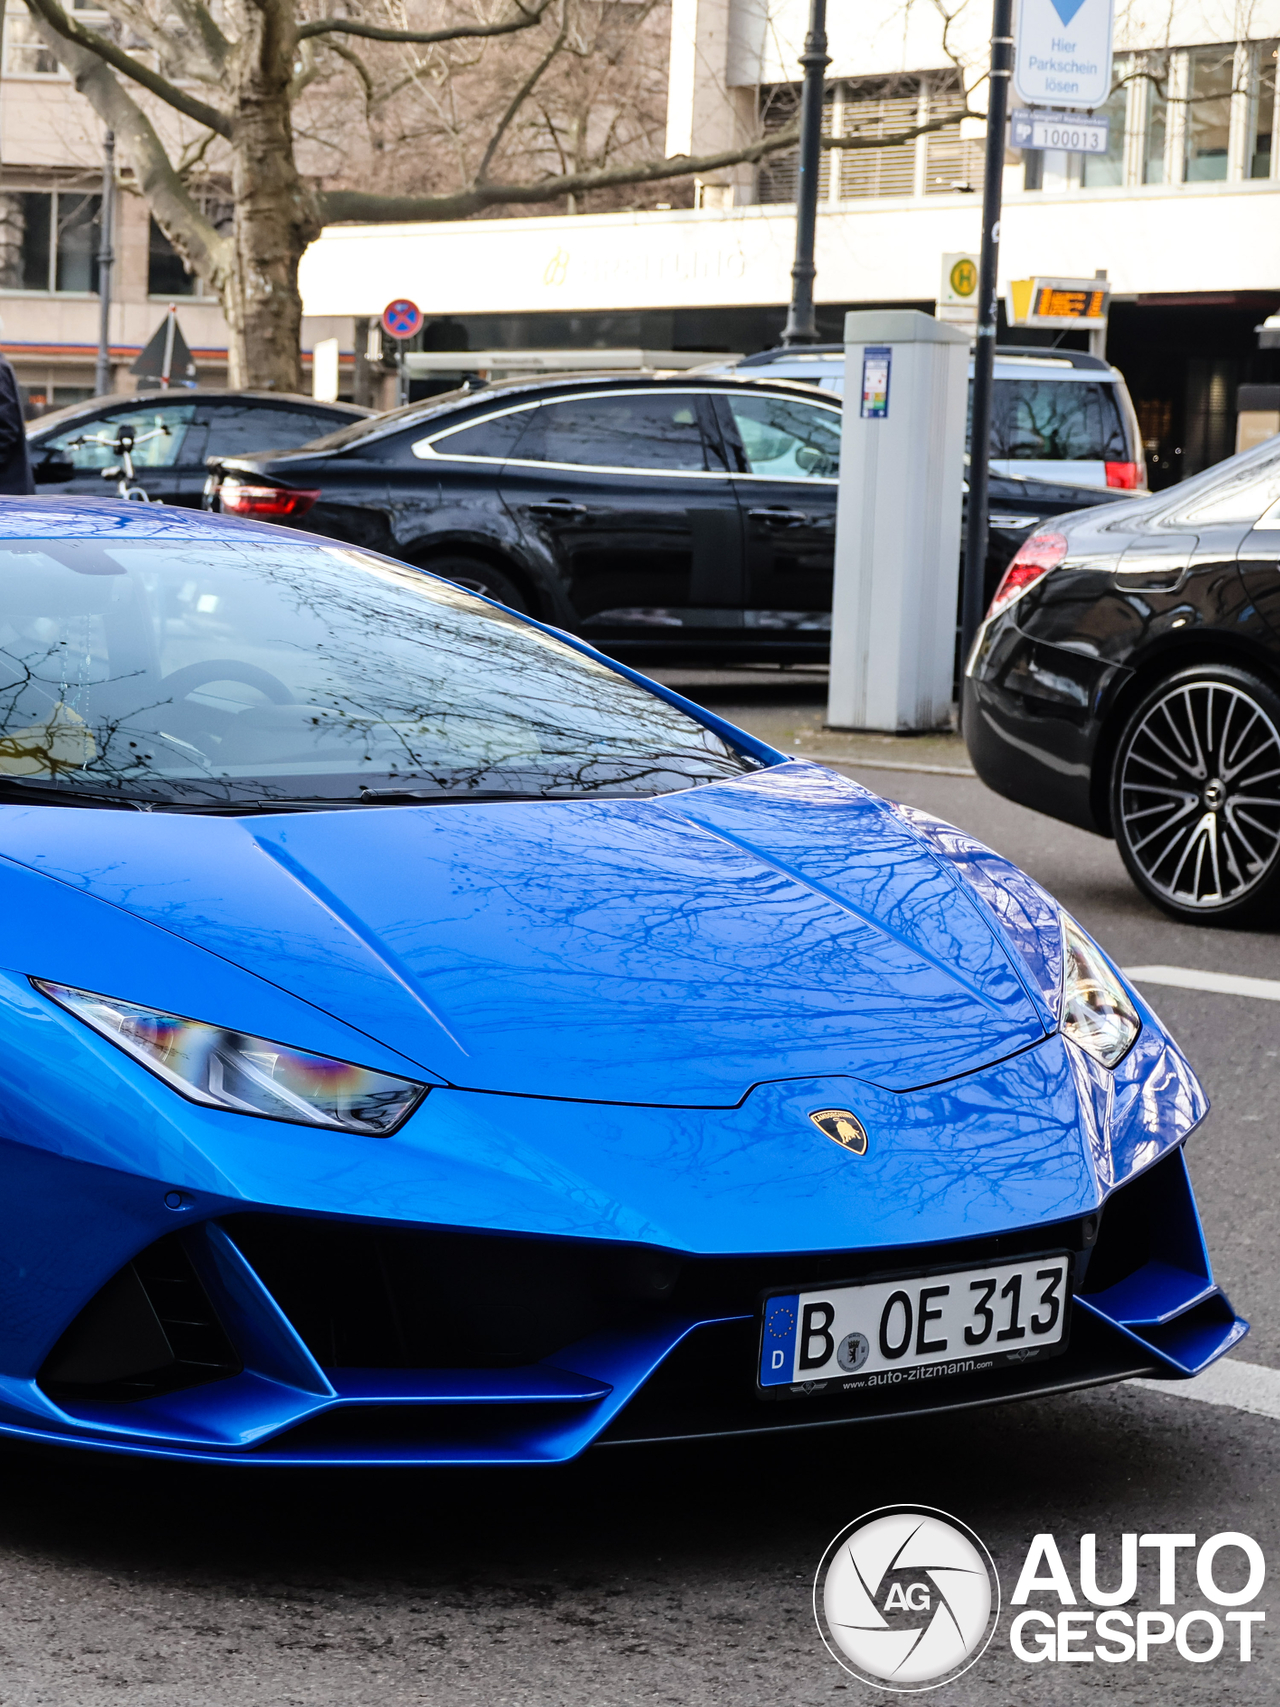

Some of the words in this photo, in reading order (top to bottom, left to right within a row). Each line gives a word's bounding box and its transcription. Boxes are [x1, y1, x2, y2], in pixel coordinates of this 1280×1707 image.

[1051, 38, 1077, 53] Hier
[1028, 56, 1098, 76] Parkschein
[1045, 77, 1079, 93] lösen
[1044, 129, 1099, 150] 100013
[799, 1301, 835, 1370] B
[879, 1284, 950, 1360] OE
[964, 1266, 1063, 1346] 313
[771, 1350, 784, 1370] D
[843, 1360, 993, 1390] www.auto-zitzmann.com
